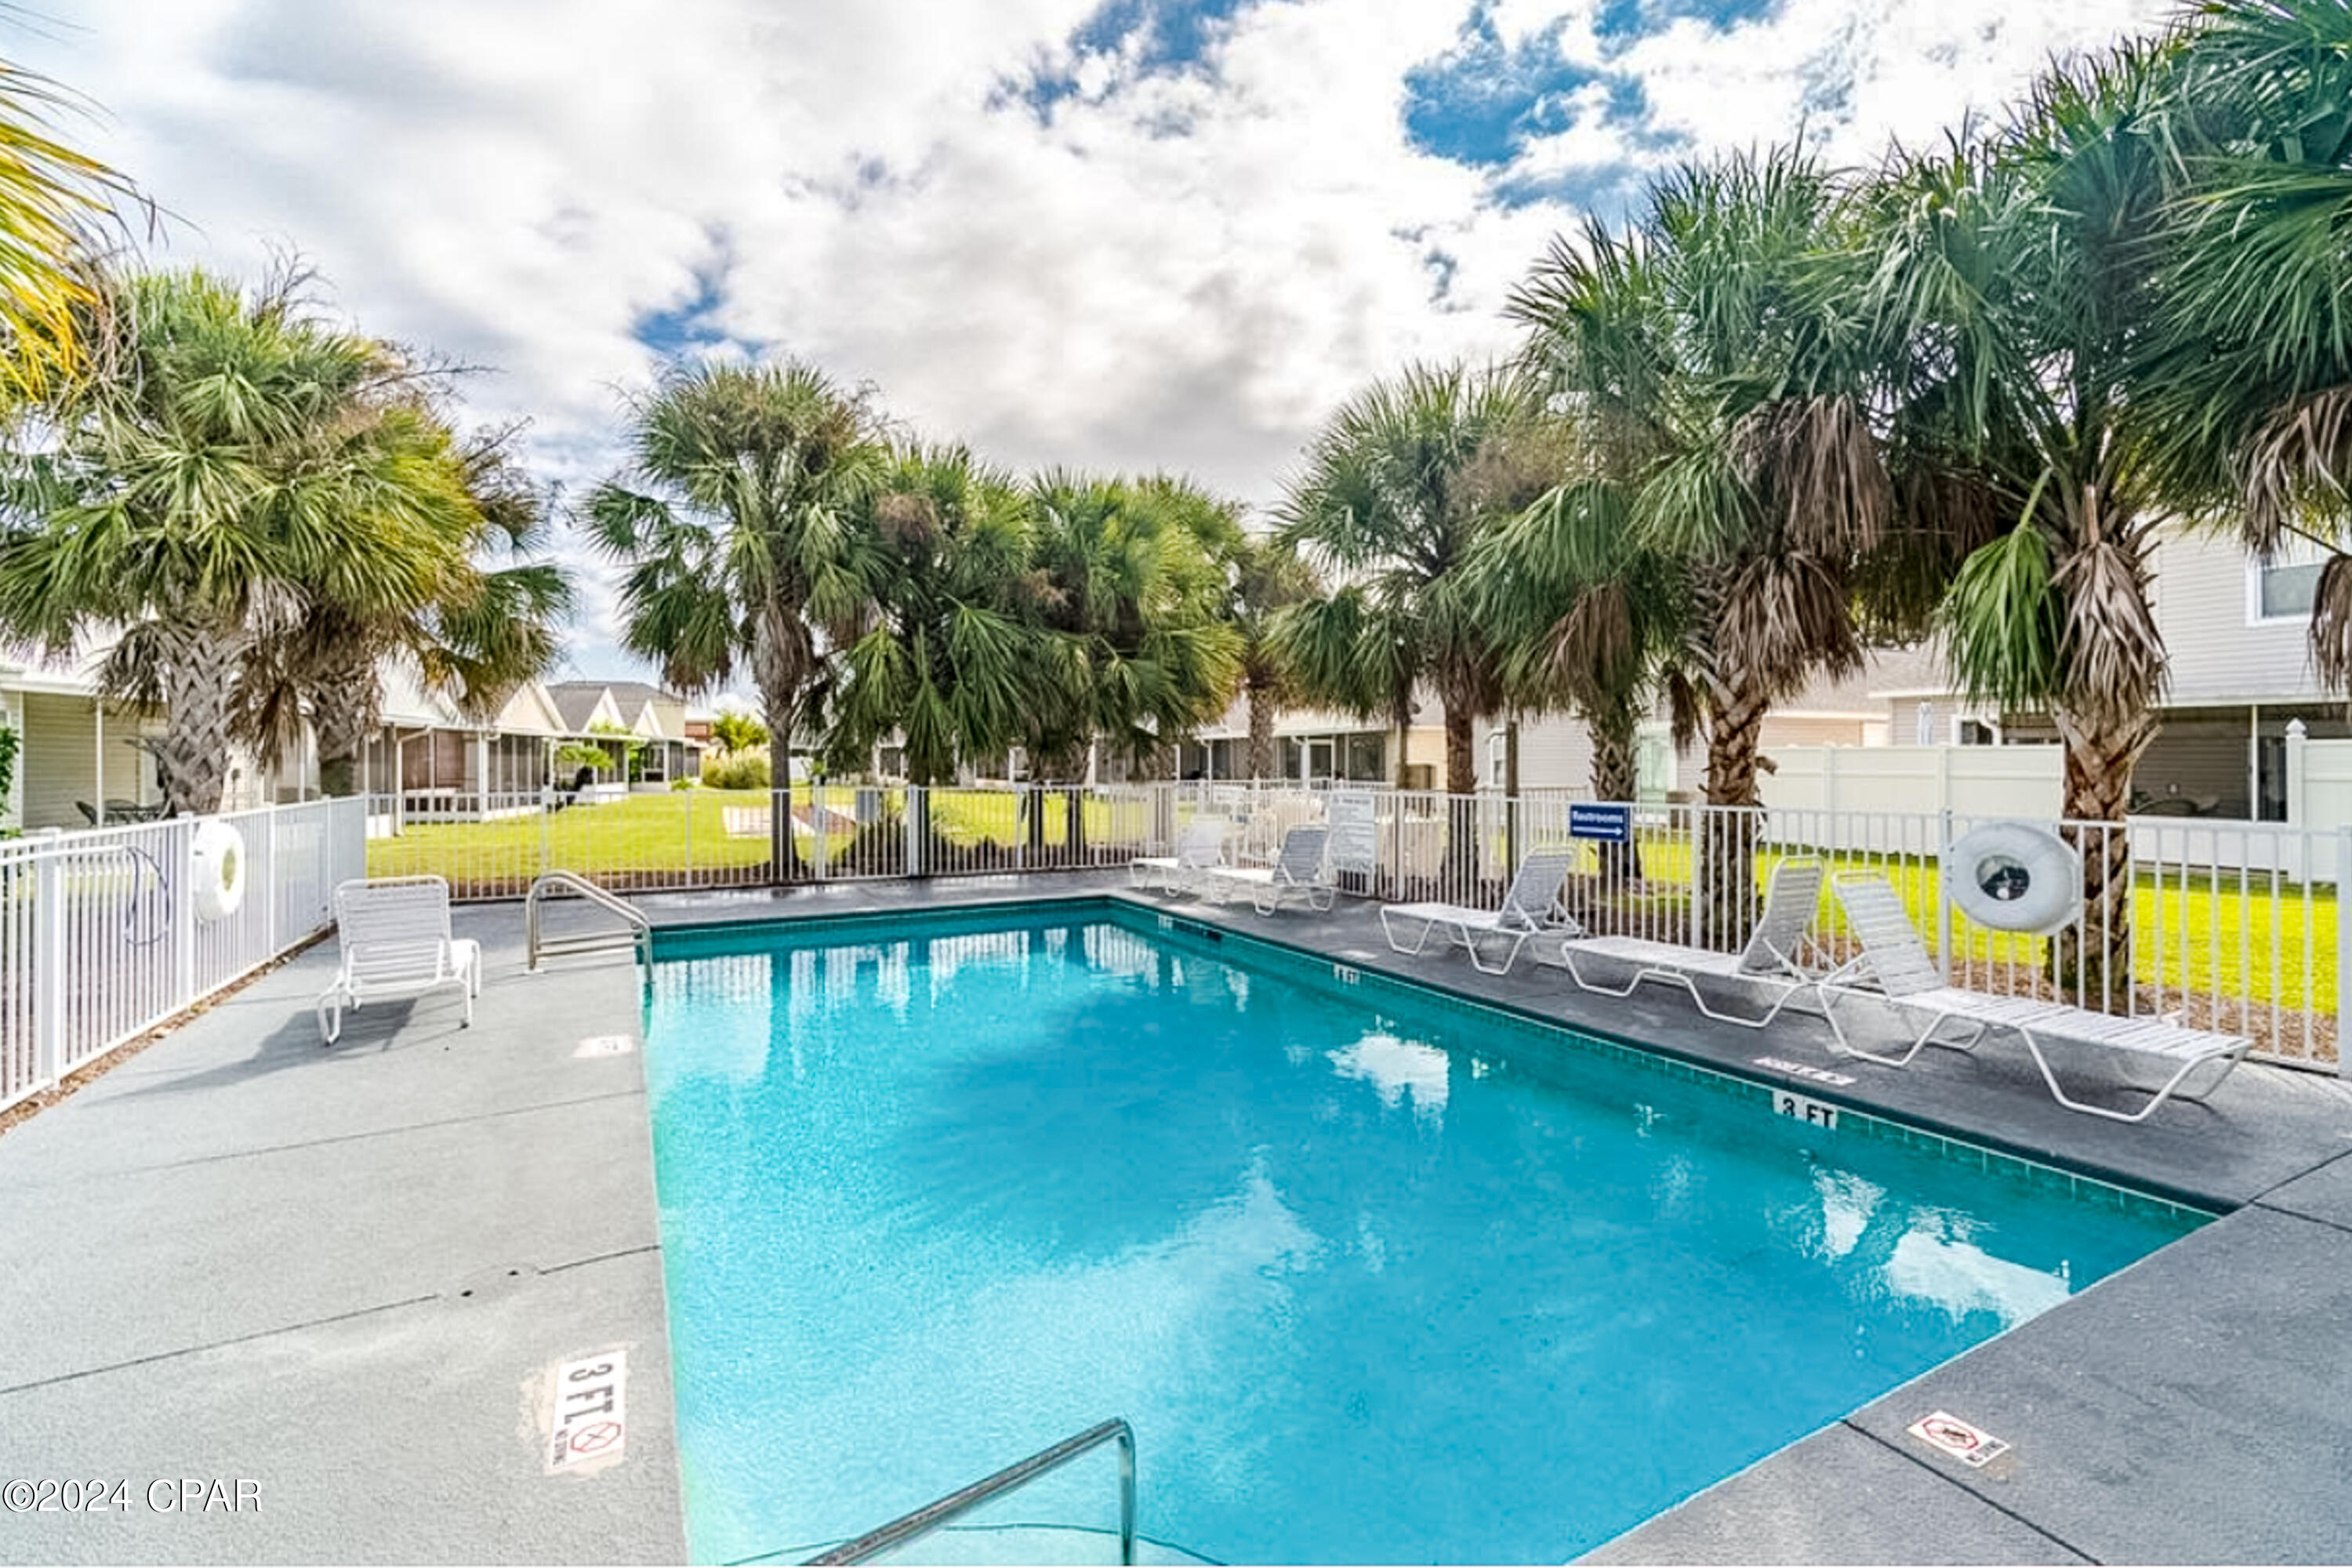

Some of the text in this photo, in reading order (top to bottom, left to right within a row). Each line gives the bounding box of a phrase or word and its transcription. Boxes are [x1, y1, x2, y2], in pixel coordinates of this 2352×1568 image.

[1783, 1098, 1835, 1127] 3 FT
[568, 1363, 614, 1381] 3
